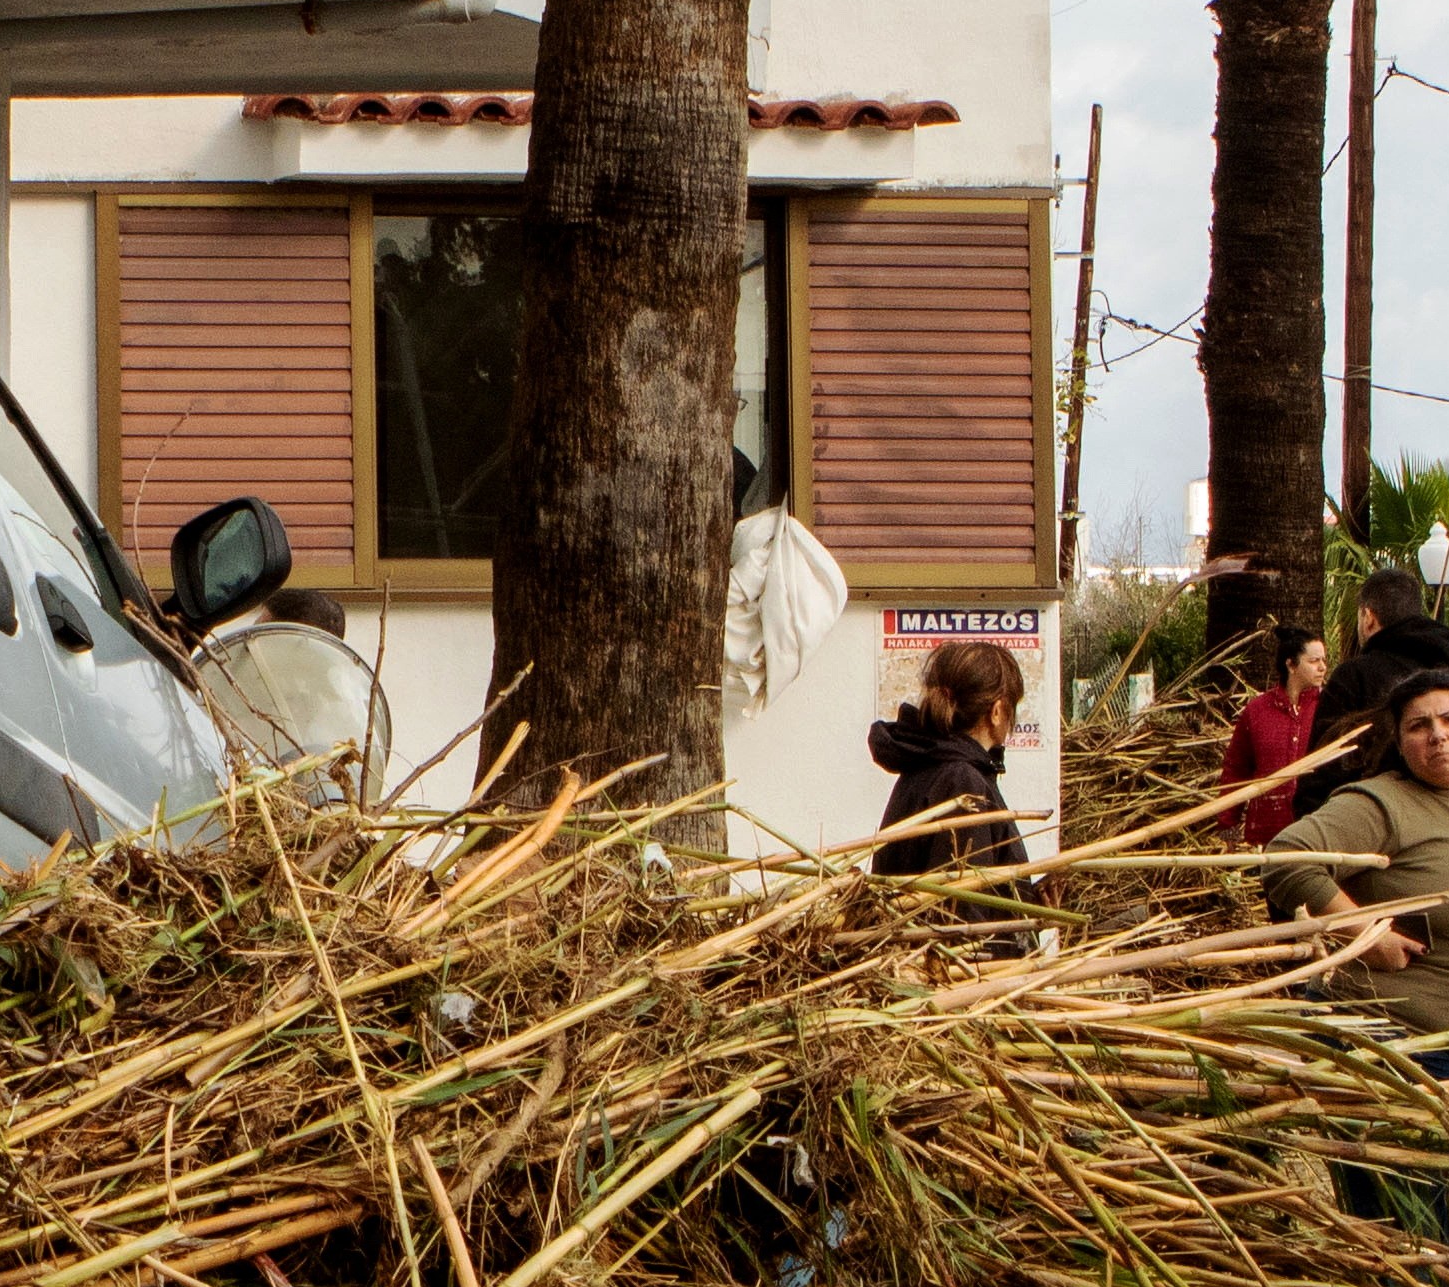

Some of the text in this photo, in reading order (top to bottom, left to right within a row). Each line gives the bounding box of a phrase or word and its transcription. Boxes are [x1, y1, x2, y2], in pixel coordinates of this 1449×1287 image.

[901, 613, 1035, 631] MALTEZOS
[887, 639, 933, 648] ΗΛΙΑΚΑ
[1014, 723, 1040, 734] ΔΟΣ
